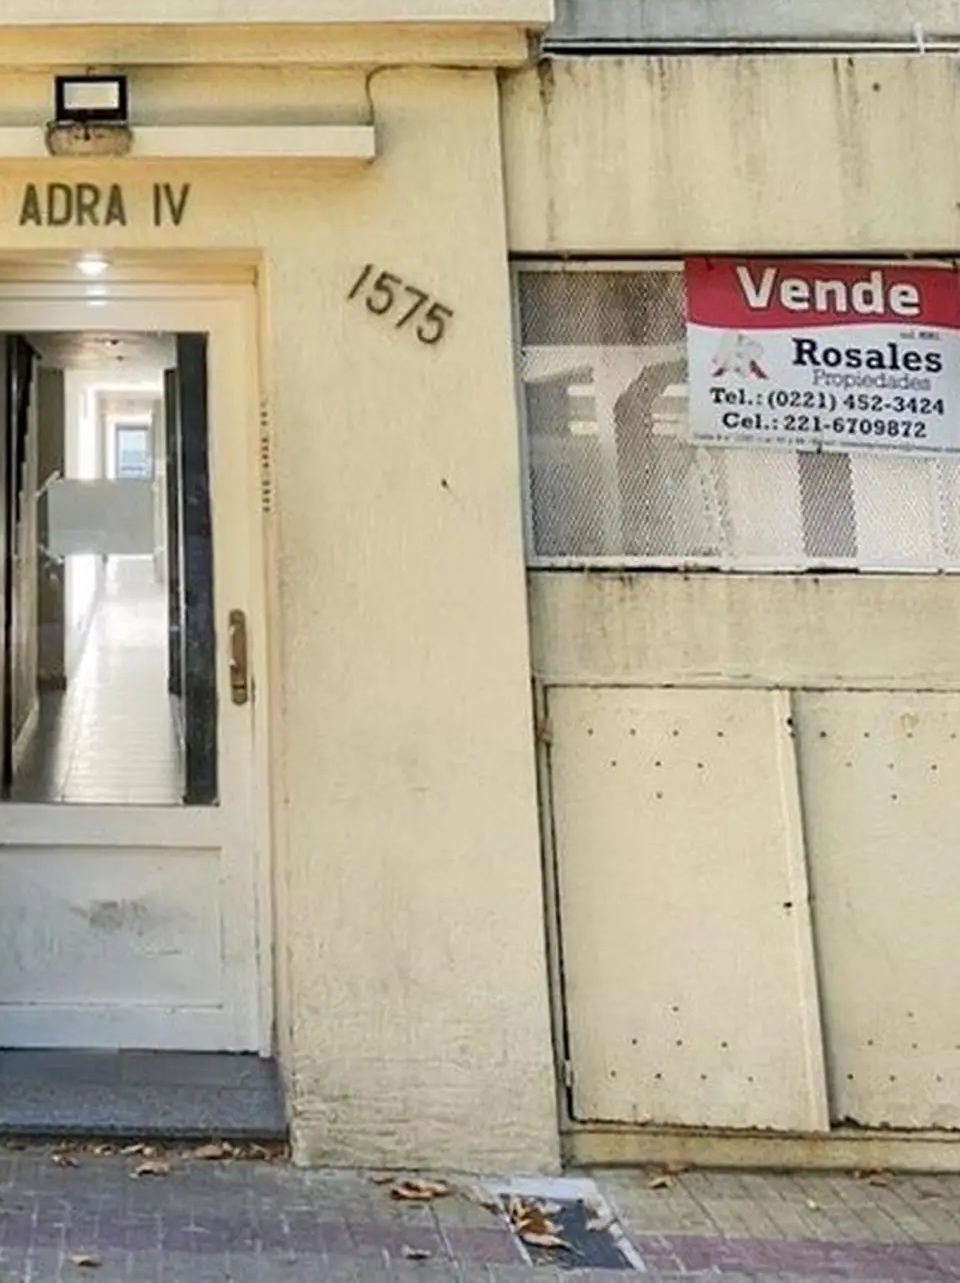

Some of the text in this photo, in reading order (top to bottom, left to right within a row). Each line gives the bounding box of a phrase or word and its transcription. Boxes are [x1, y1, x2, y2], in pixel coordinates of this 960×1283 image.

[18, 182, 192, 227] ADRA IV
[347, 263, 454, 346] 1575
[736, 266, 920, 316] Vende
[792, 337, 943, 373] Rosales
[812, 369, 932, 391] Propiedades
[710, 387, 945, 416] Tel.: (0221) 452-3424
[722, 411, 927, 439] Cel.: 221-6709872
